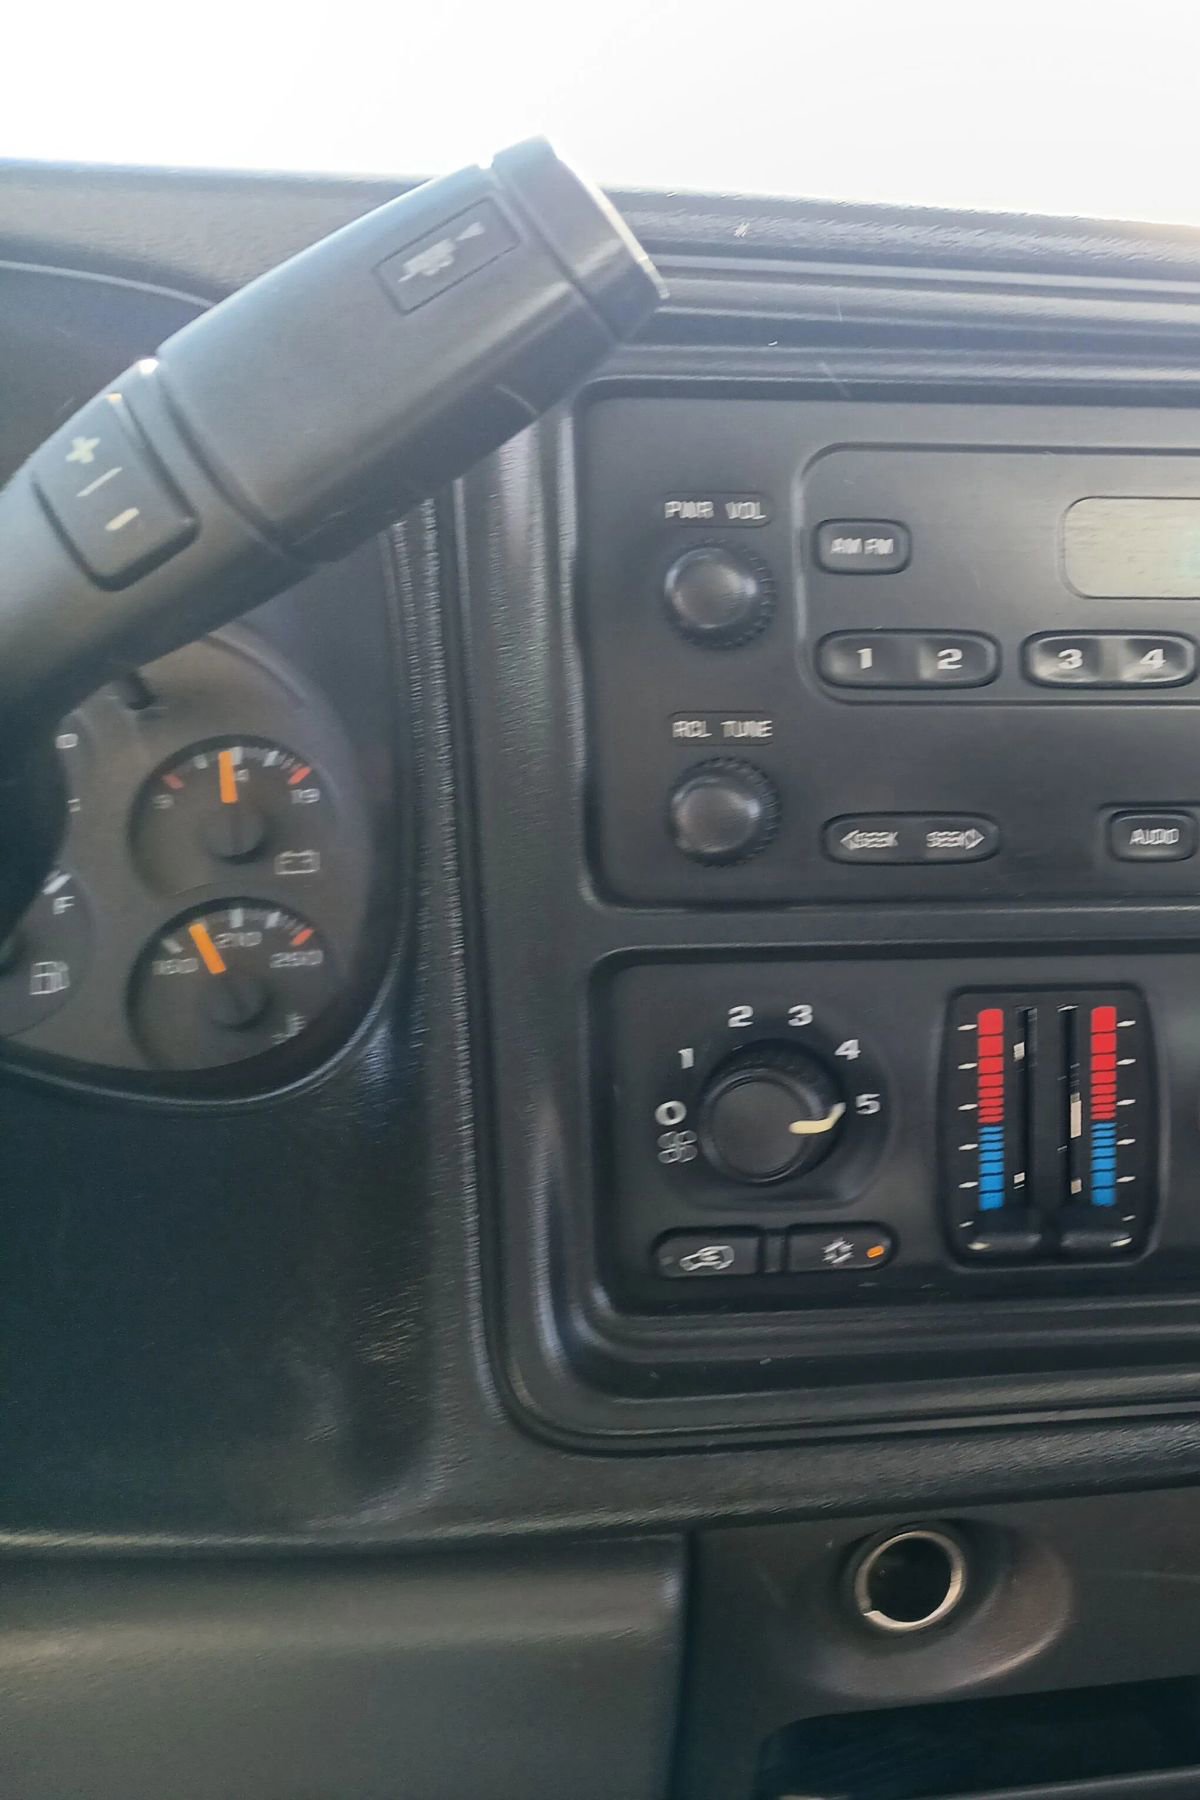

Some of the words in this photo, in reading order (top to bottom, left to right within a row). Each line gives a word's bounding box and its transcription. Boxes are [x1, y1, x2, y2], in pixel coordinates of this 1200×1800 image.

[724, 501, 767, 519] VOL
[857, 647, 873, 669] 1
[936, 647, 963, 670] 2
[1057, 648, 1084, 669] 3
[1139, 648, 1167, 669] 4
[720, 720, 773, 739] TUNE
[728, 1005, 754, 1028] 2
[787, 1004, 814, 1027] 3
[677, 1047, 695, 1069] 1
[834, 1039, 861, 1061] 4
[855, 1093, 881, 1115] 5
